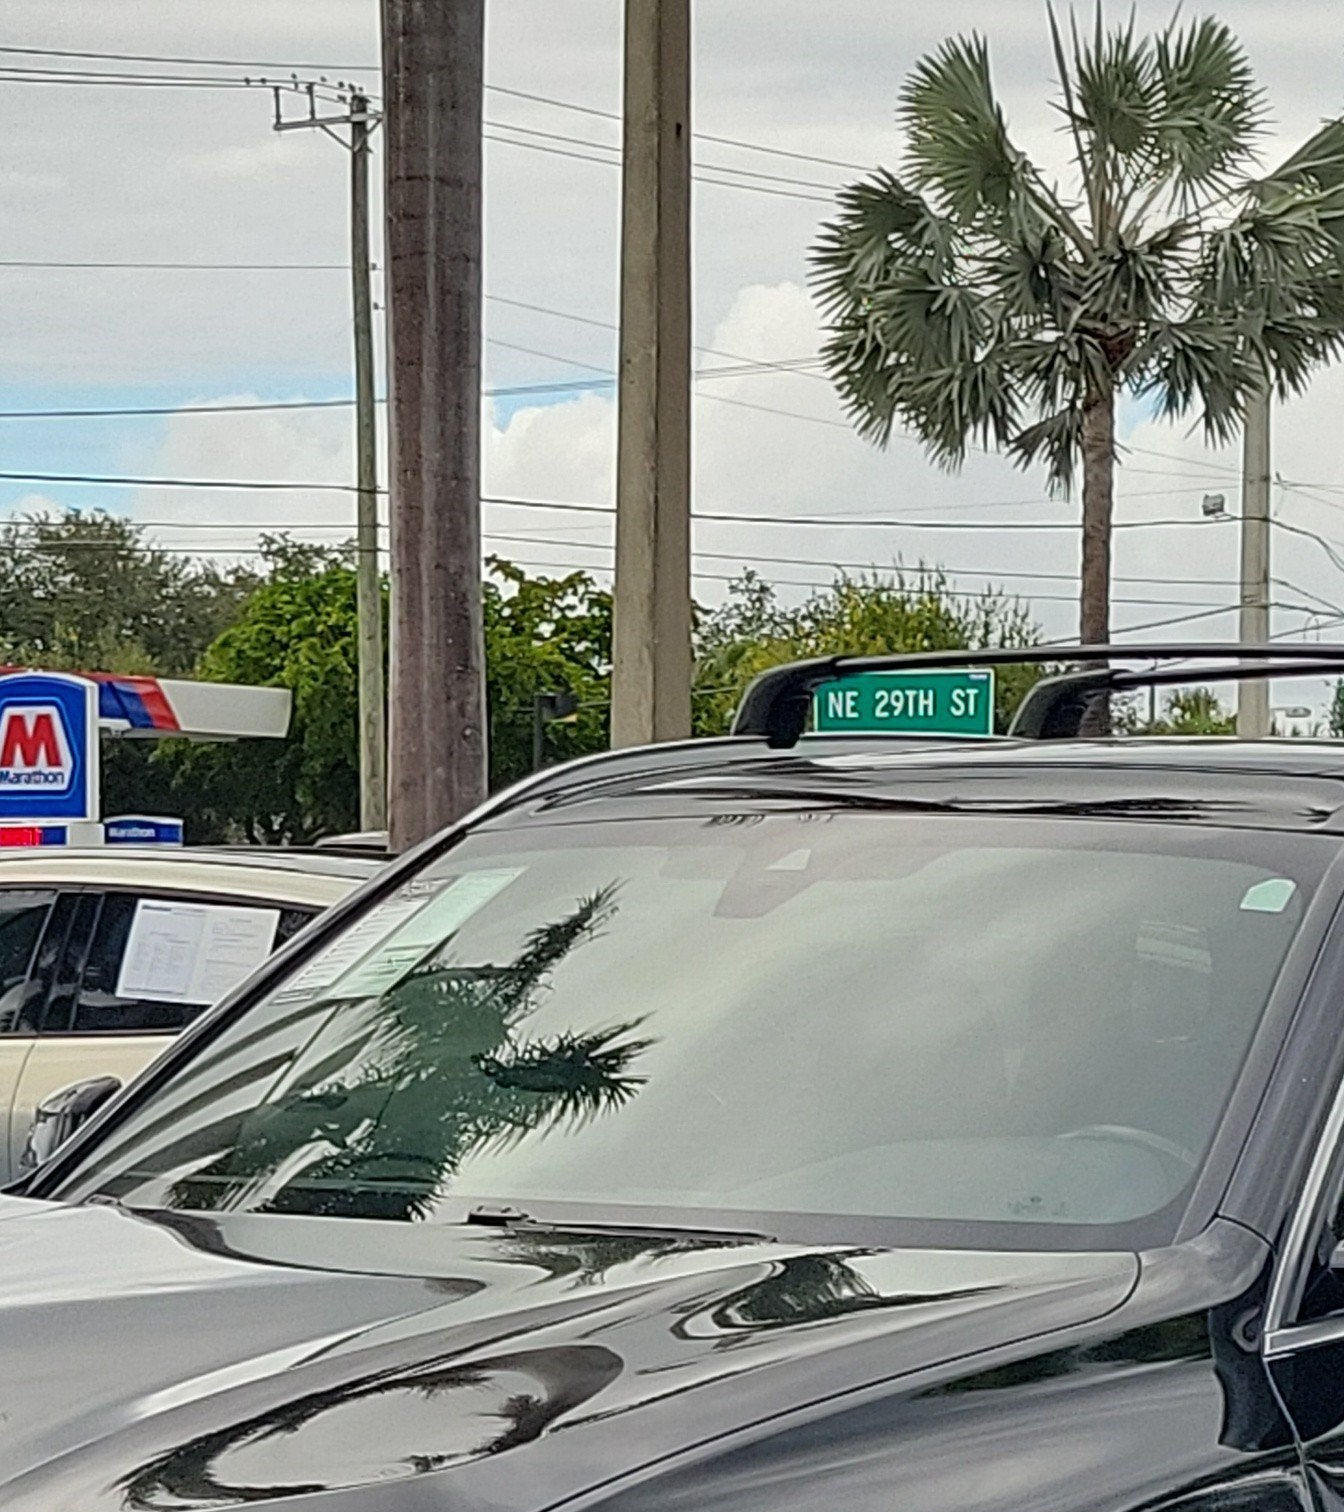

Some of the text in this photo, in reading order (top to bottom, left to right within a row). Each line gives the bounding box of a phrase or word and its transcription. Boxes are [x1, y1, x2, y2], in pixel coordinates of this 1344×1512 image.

[828, 688, 979, 718] NE 29TH ST
[0, 714, 63, 768] M
